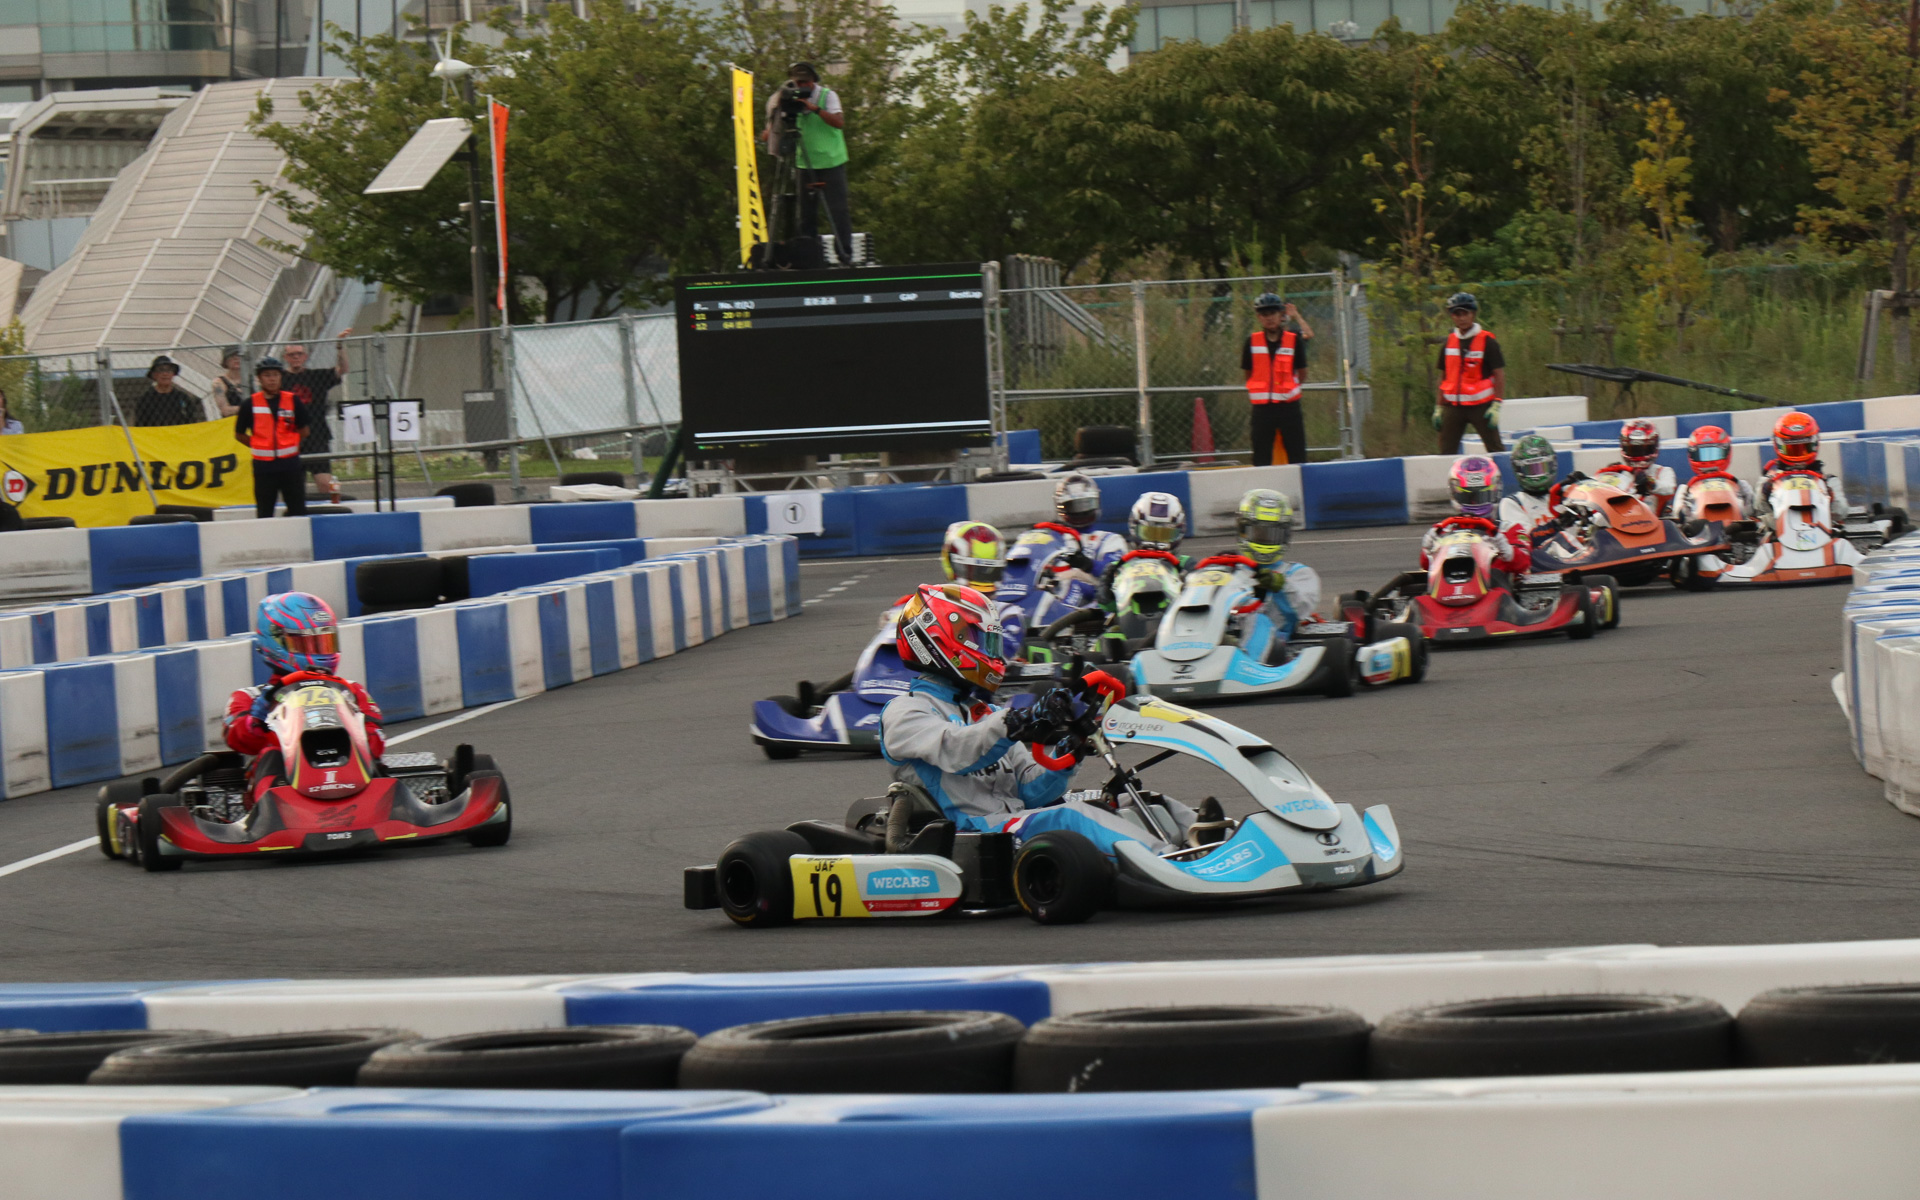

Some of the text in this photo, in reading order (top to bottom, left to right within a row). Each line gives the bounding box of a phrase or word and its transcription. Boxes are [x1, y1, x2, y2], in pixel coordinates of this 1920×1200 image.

[353, 415, 365, 435] 1
[397, 411, 411, 432] 5
[43, 453, 238, 501] DUNLOP
[1119, 721, 1164, 732] ITOCHU ENEX
[326, 831, 352, 840] TOM'S
[815, 860, 836, 872] JAF
[1194, 847, 1254, 876] WECARS
[872, 875, 931, 889] WECARS
[810, 872, 842, 917] 19
